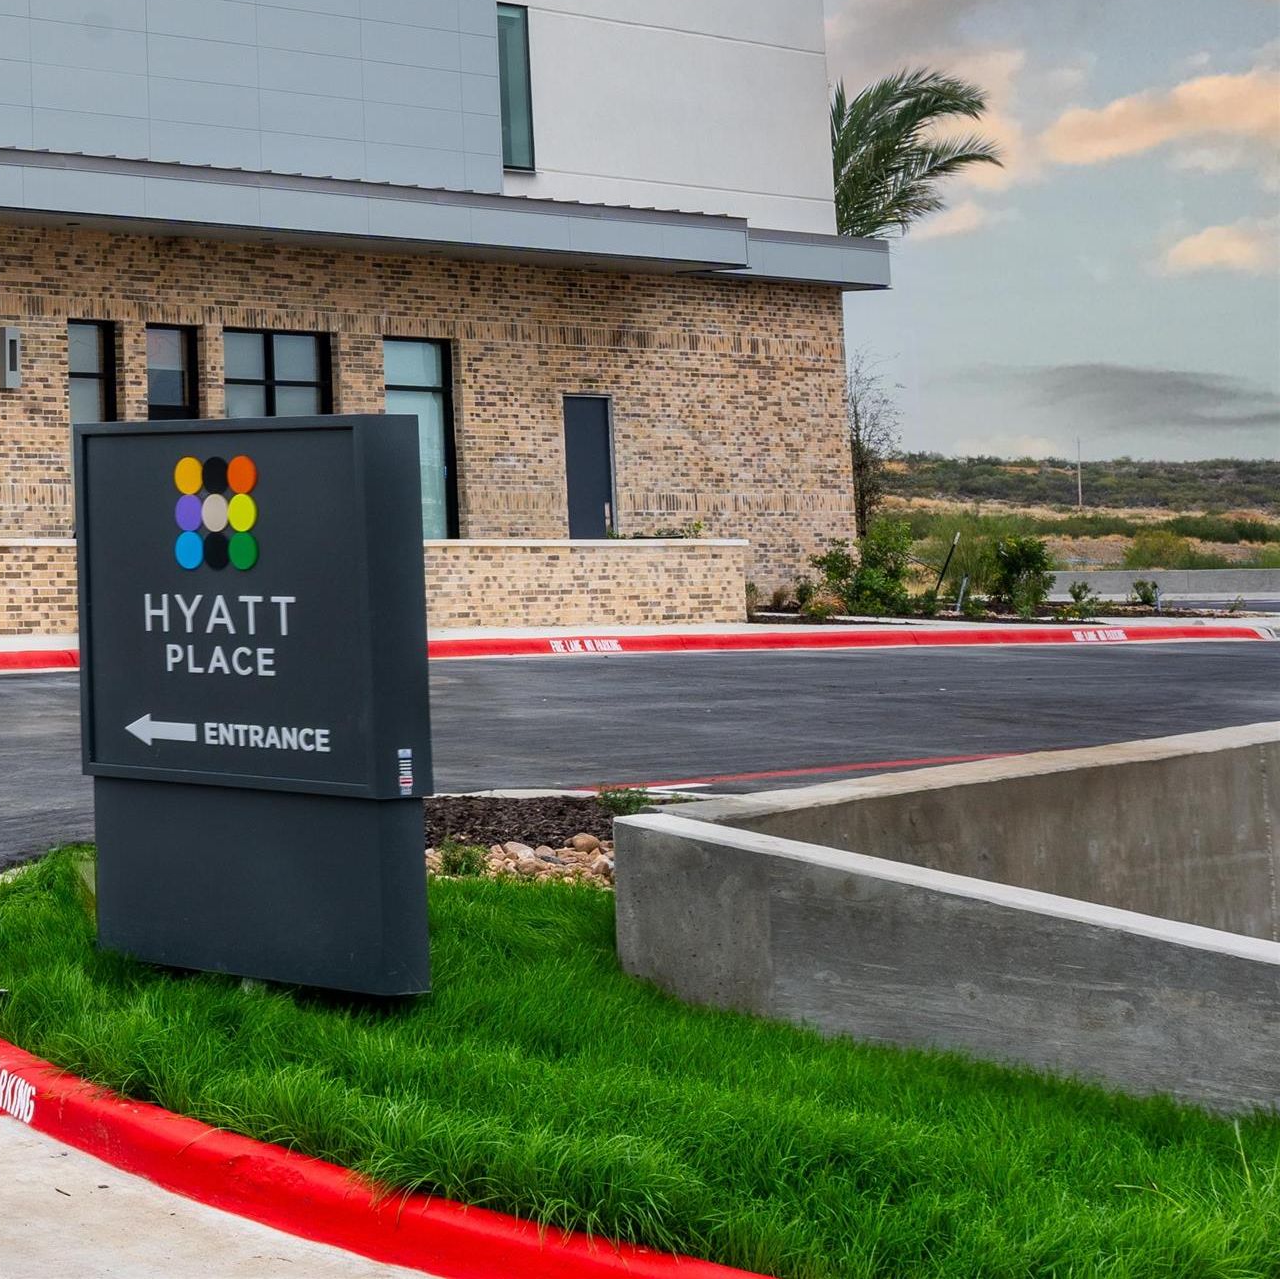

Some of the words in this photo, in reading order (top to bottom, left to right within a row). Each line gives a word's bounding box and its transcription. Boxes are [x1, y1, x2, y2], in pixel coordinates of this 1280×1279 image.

[144, 593, 296, 636] HYATT
[166, 644, 276, 676] PLACE
[204, 722, 331, 752] ENTRANCE
